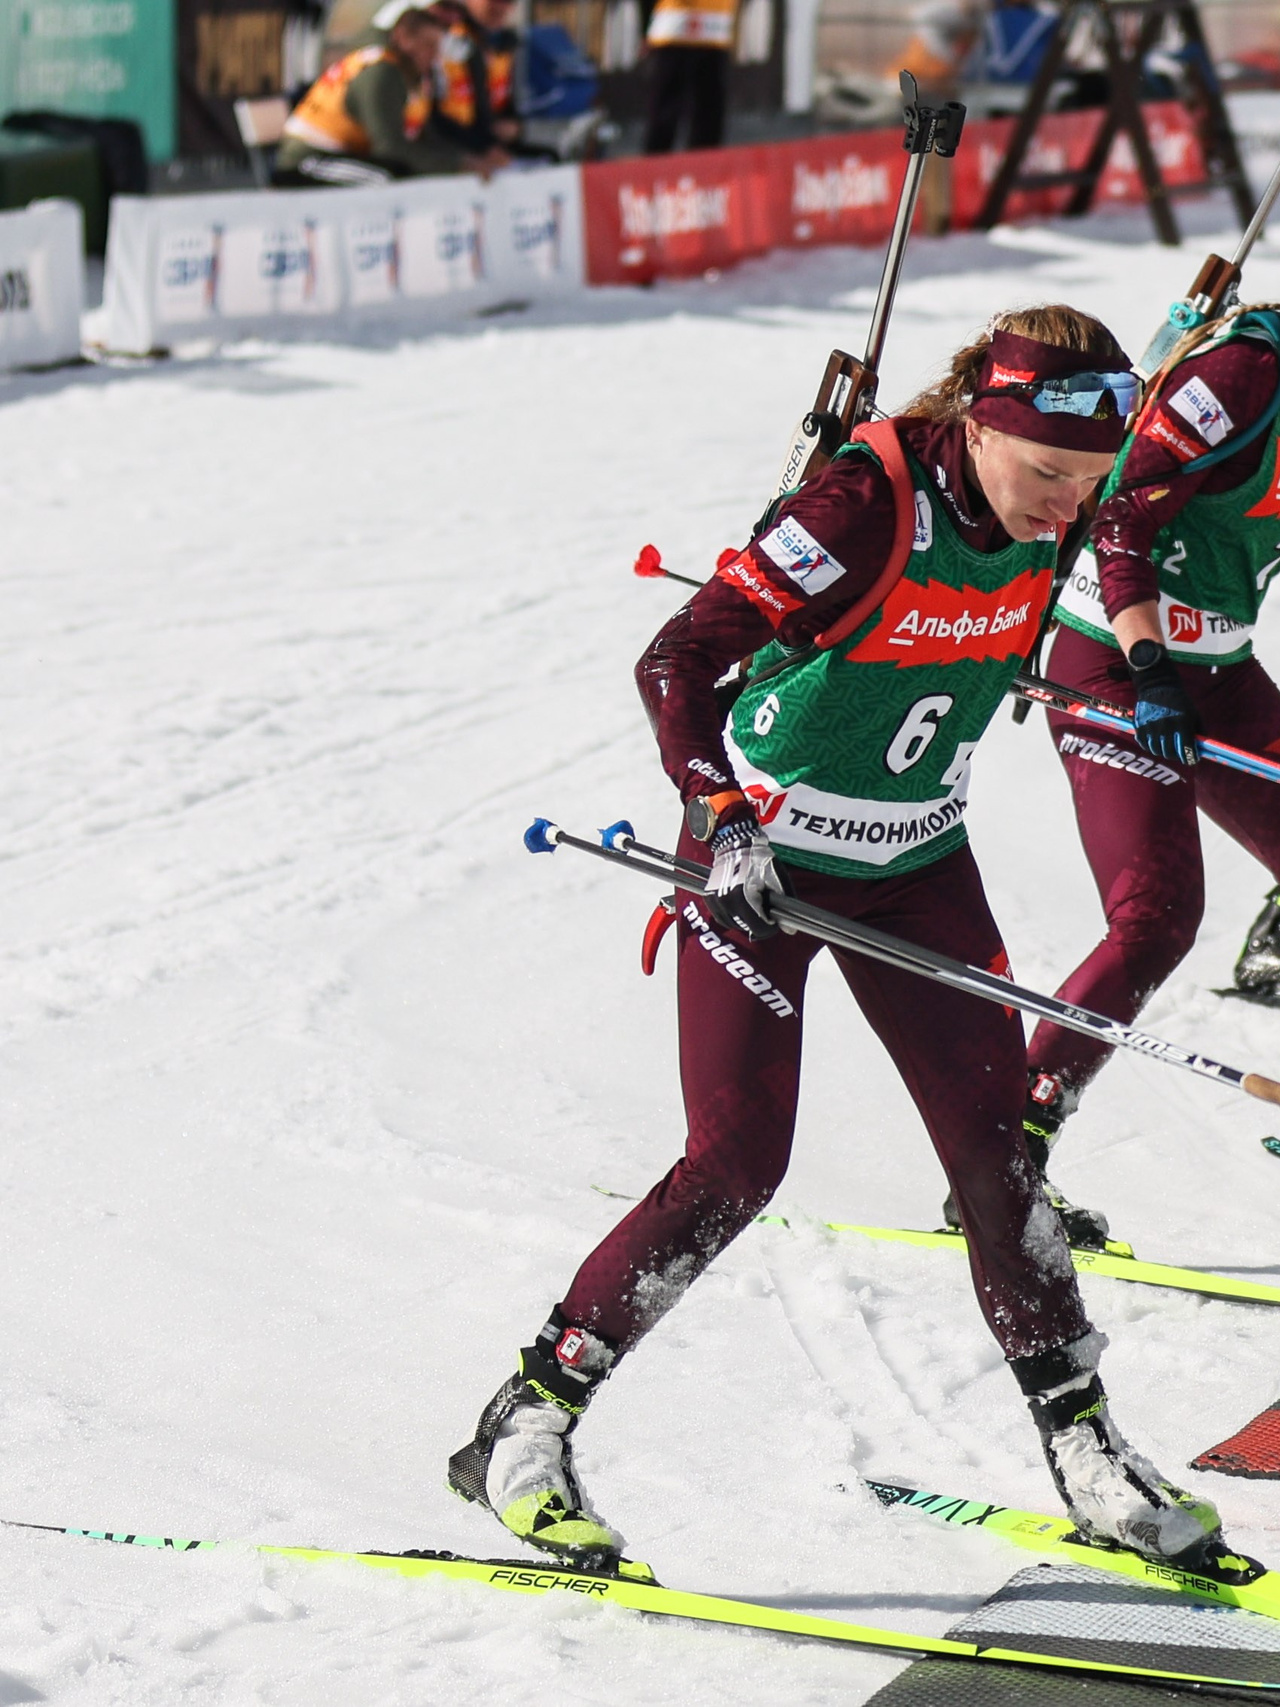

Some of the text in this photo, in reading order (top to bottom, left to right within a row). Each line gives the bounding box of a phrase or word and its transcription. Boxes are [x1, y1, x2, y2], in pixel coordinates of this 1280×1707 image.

[776, 528, 804, 557] СБР
[1162, 540, 1187, 575] 2
[730, 562, 788, 613] Альфа Банк
[891, 601, 1032, 645] Альфа Банк
[754, 693, 780, 736] 6
[884, 692, 955, 776] 6
[1059, 732, 1181, 786] proteam
[788, 797, 968, 844] ТЕХНОНИКОЛЬ
[683, 901, 794, 1018] proteam
[489, 1569, 609, 1596] FISCHER
[1144, 1564, 1220, 1596] FISCHER
